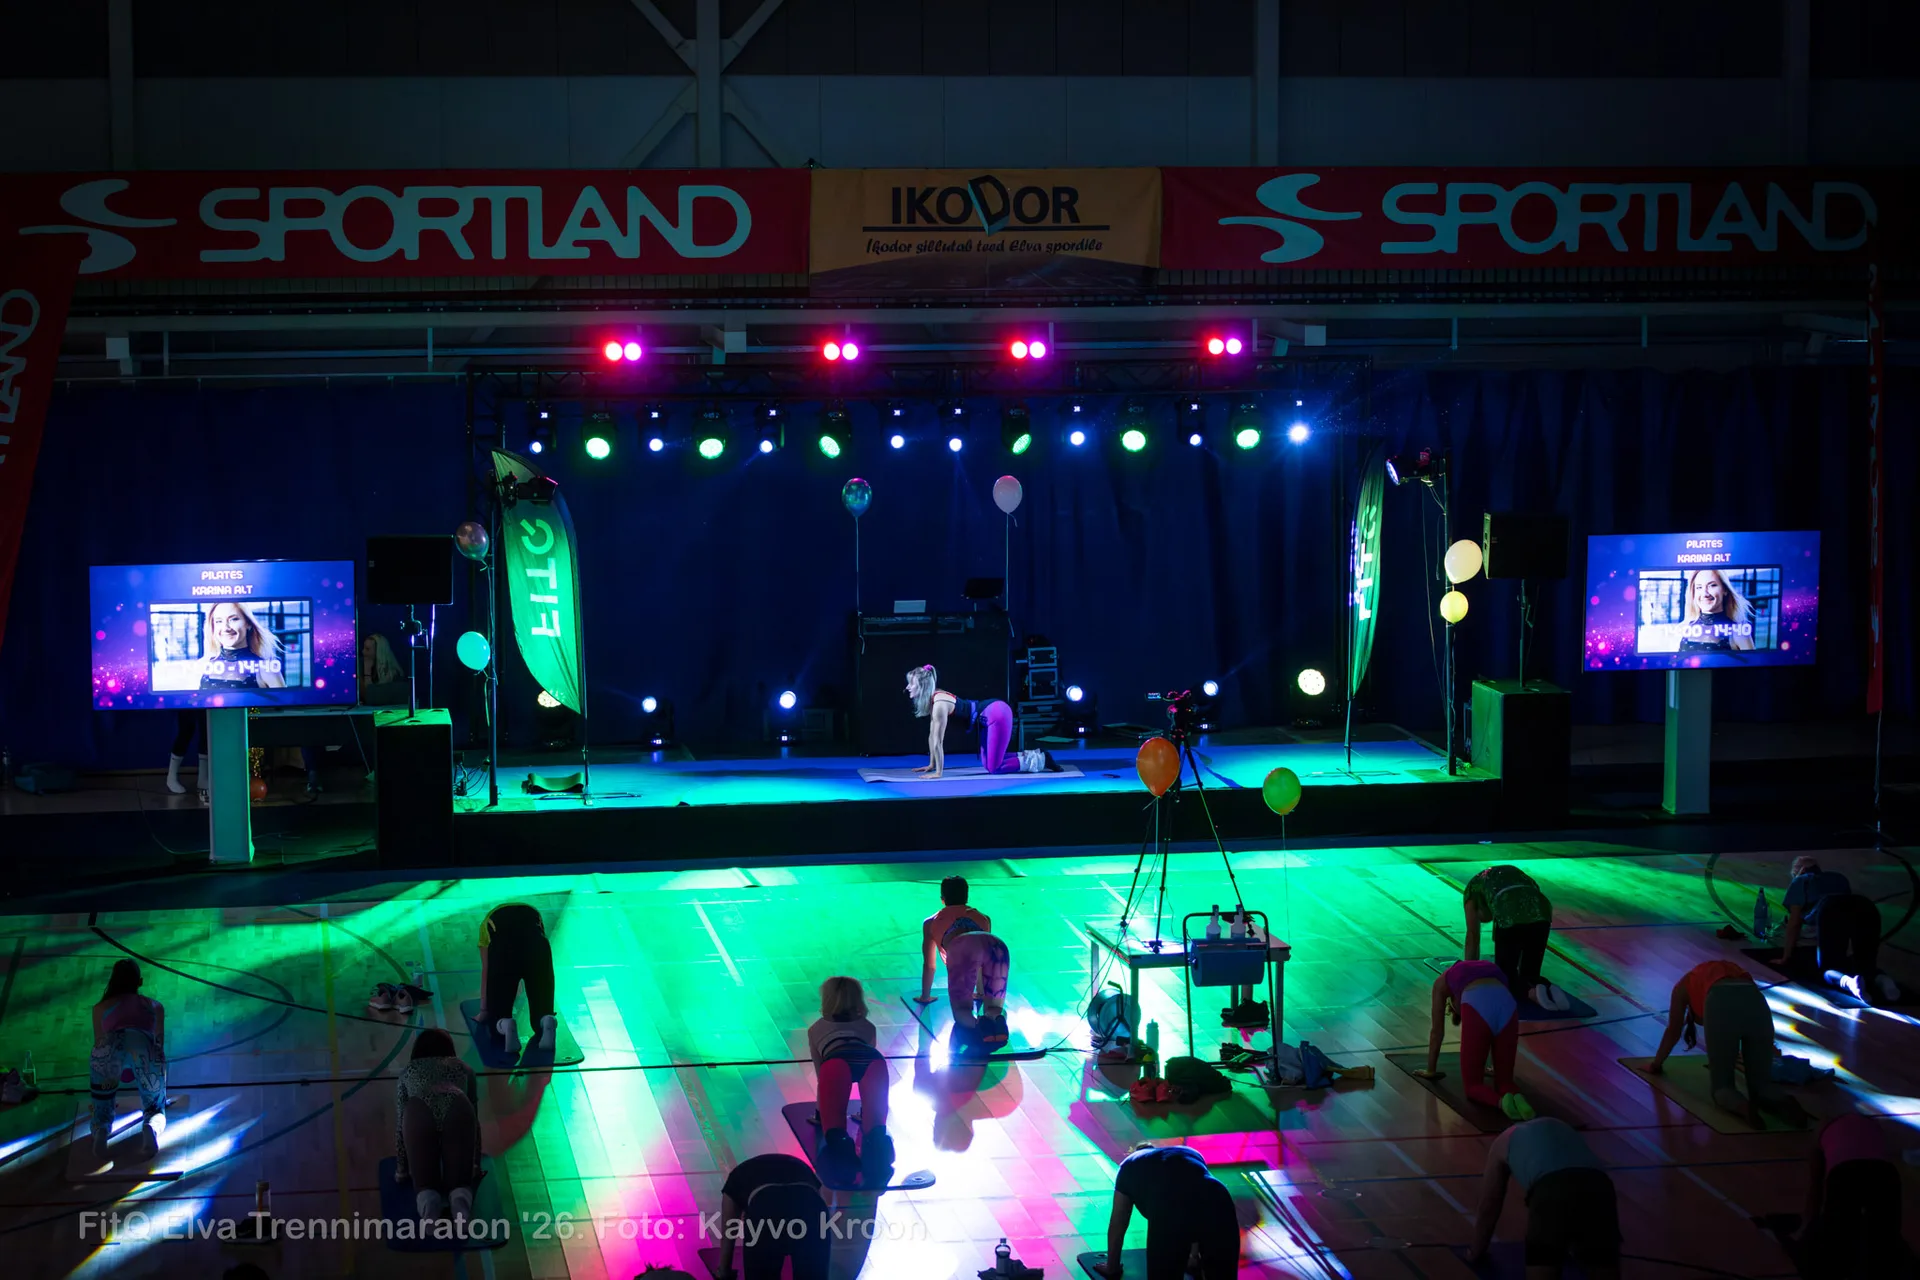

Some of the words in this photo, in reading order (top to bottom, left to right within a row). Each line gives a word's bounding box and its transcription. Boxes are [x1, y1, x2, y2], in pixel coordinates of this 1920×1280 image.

[891, 175, 1081, 236] IKODOR
[198, 185, 752, 262] SPORTLAND
[1381, 180, 1879, 255] SPORTLAND
[866, 238, 912, 255] Ikodor
[1009, 239, 1042, 252] Elva
[1046, 238, 1102, 254] spordile
[1686, 539, 1723, 549] PILATES
[1677, 554, 1712, 564] KARINA
[1713, 553, 1731, 563] ALT
[201, 570, 243, 580] PILATES
[192, 585, 232, 596] KARINA
[233, 584, 253, 595] ALT
[1714, 623, 1752, 636] 14:40
[238, 659, 282, 673] 14:40
